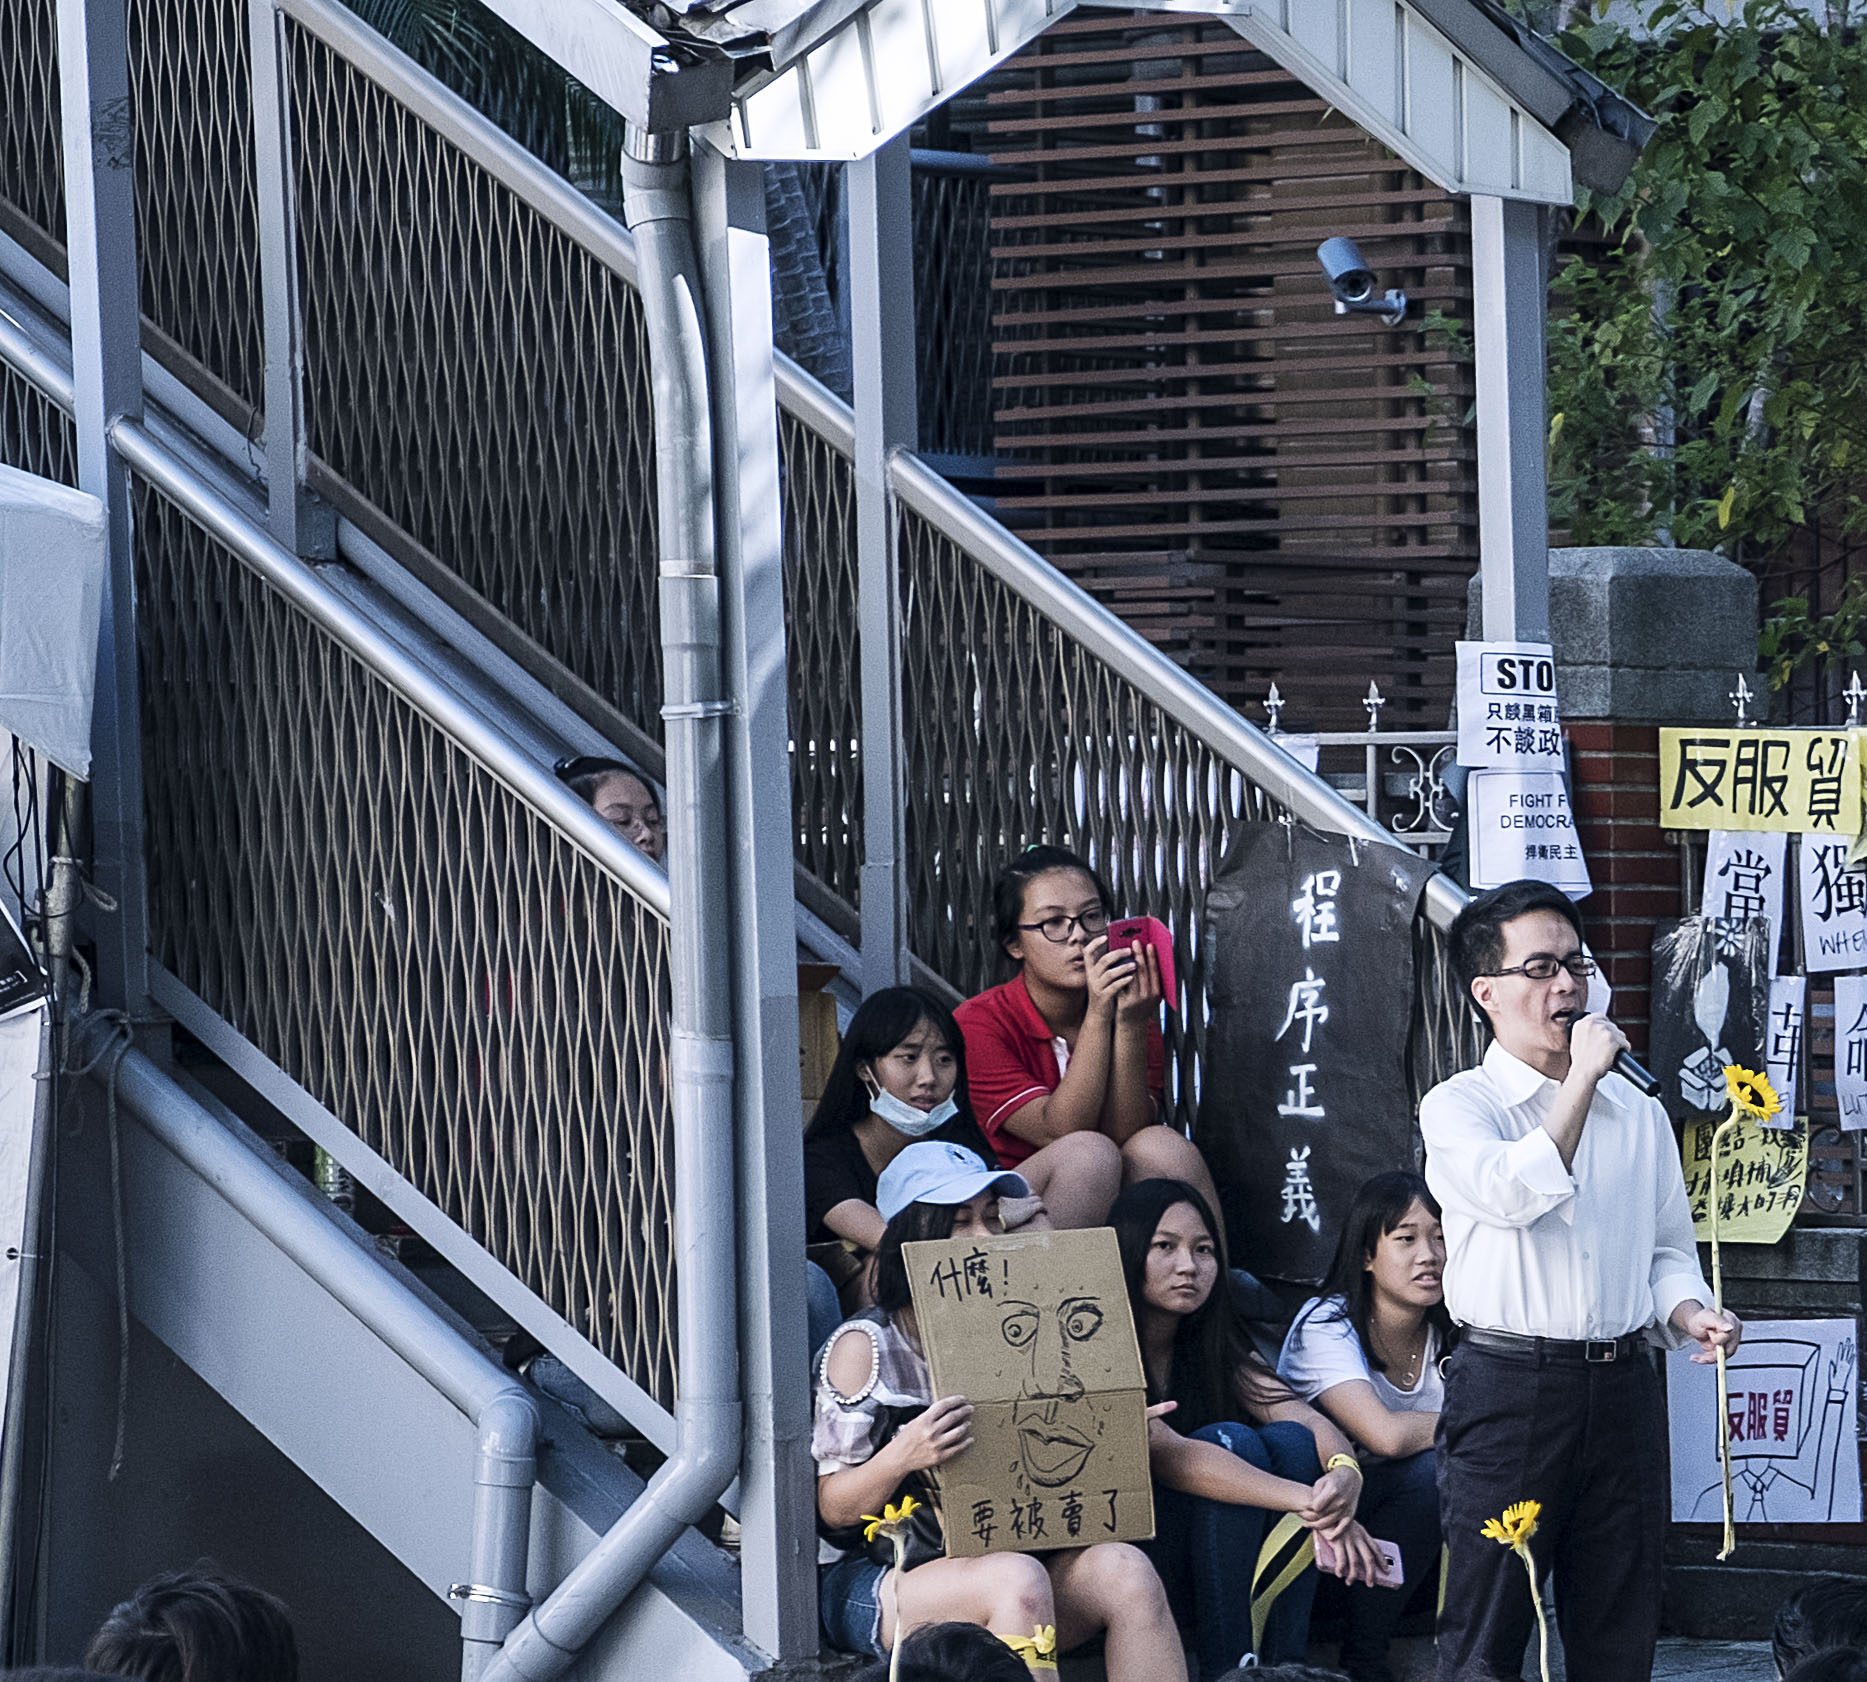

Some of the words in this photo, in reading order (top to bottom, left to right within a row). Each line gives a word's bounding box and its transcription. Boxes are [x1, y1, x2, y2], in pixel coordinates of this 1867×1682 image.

[1487, 726, 1560, 756] 不談政
[1509, 795, 1549, 809] FIGHT
[1671, 737, 1846, 829] 反服貿
[1525, 844, 1578, 860] 捍衛民主
[1275, 870, 1342, 1232] 程序正義
[1726, 1388, 1794, 1443] 反服貿
[971, 1488, 1120, 1549] 要被賣了
